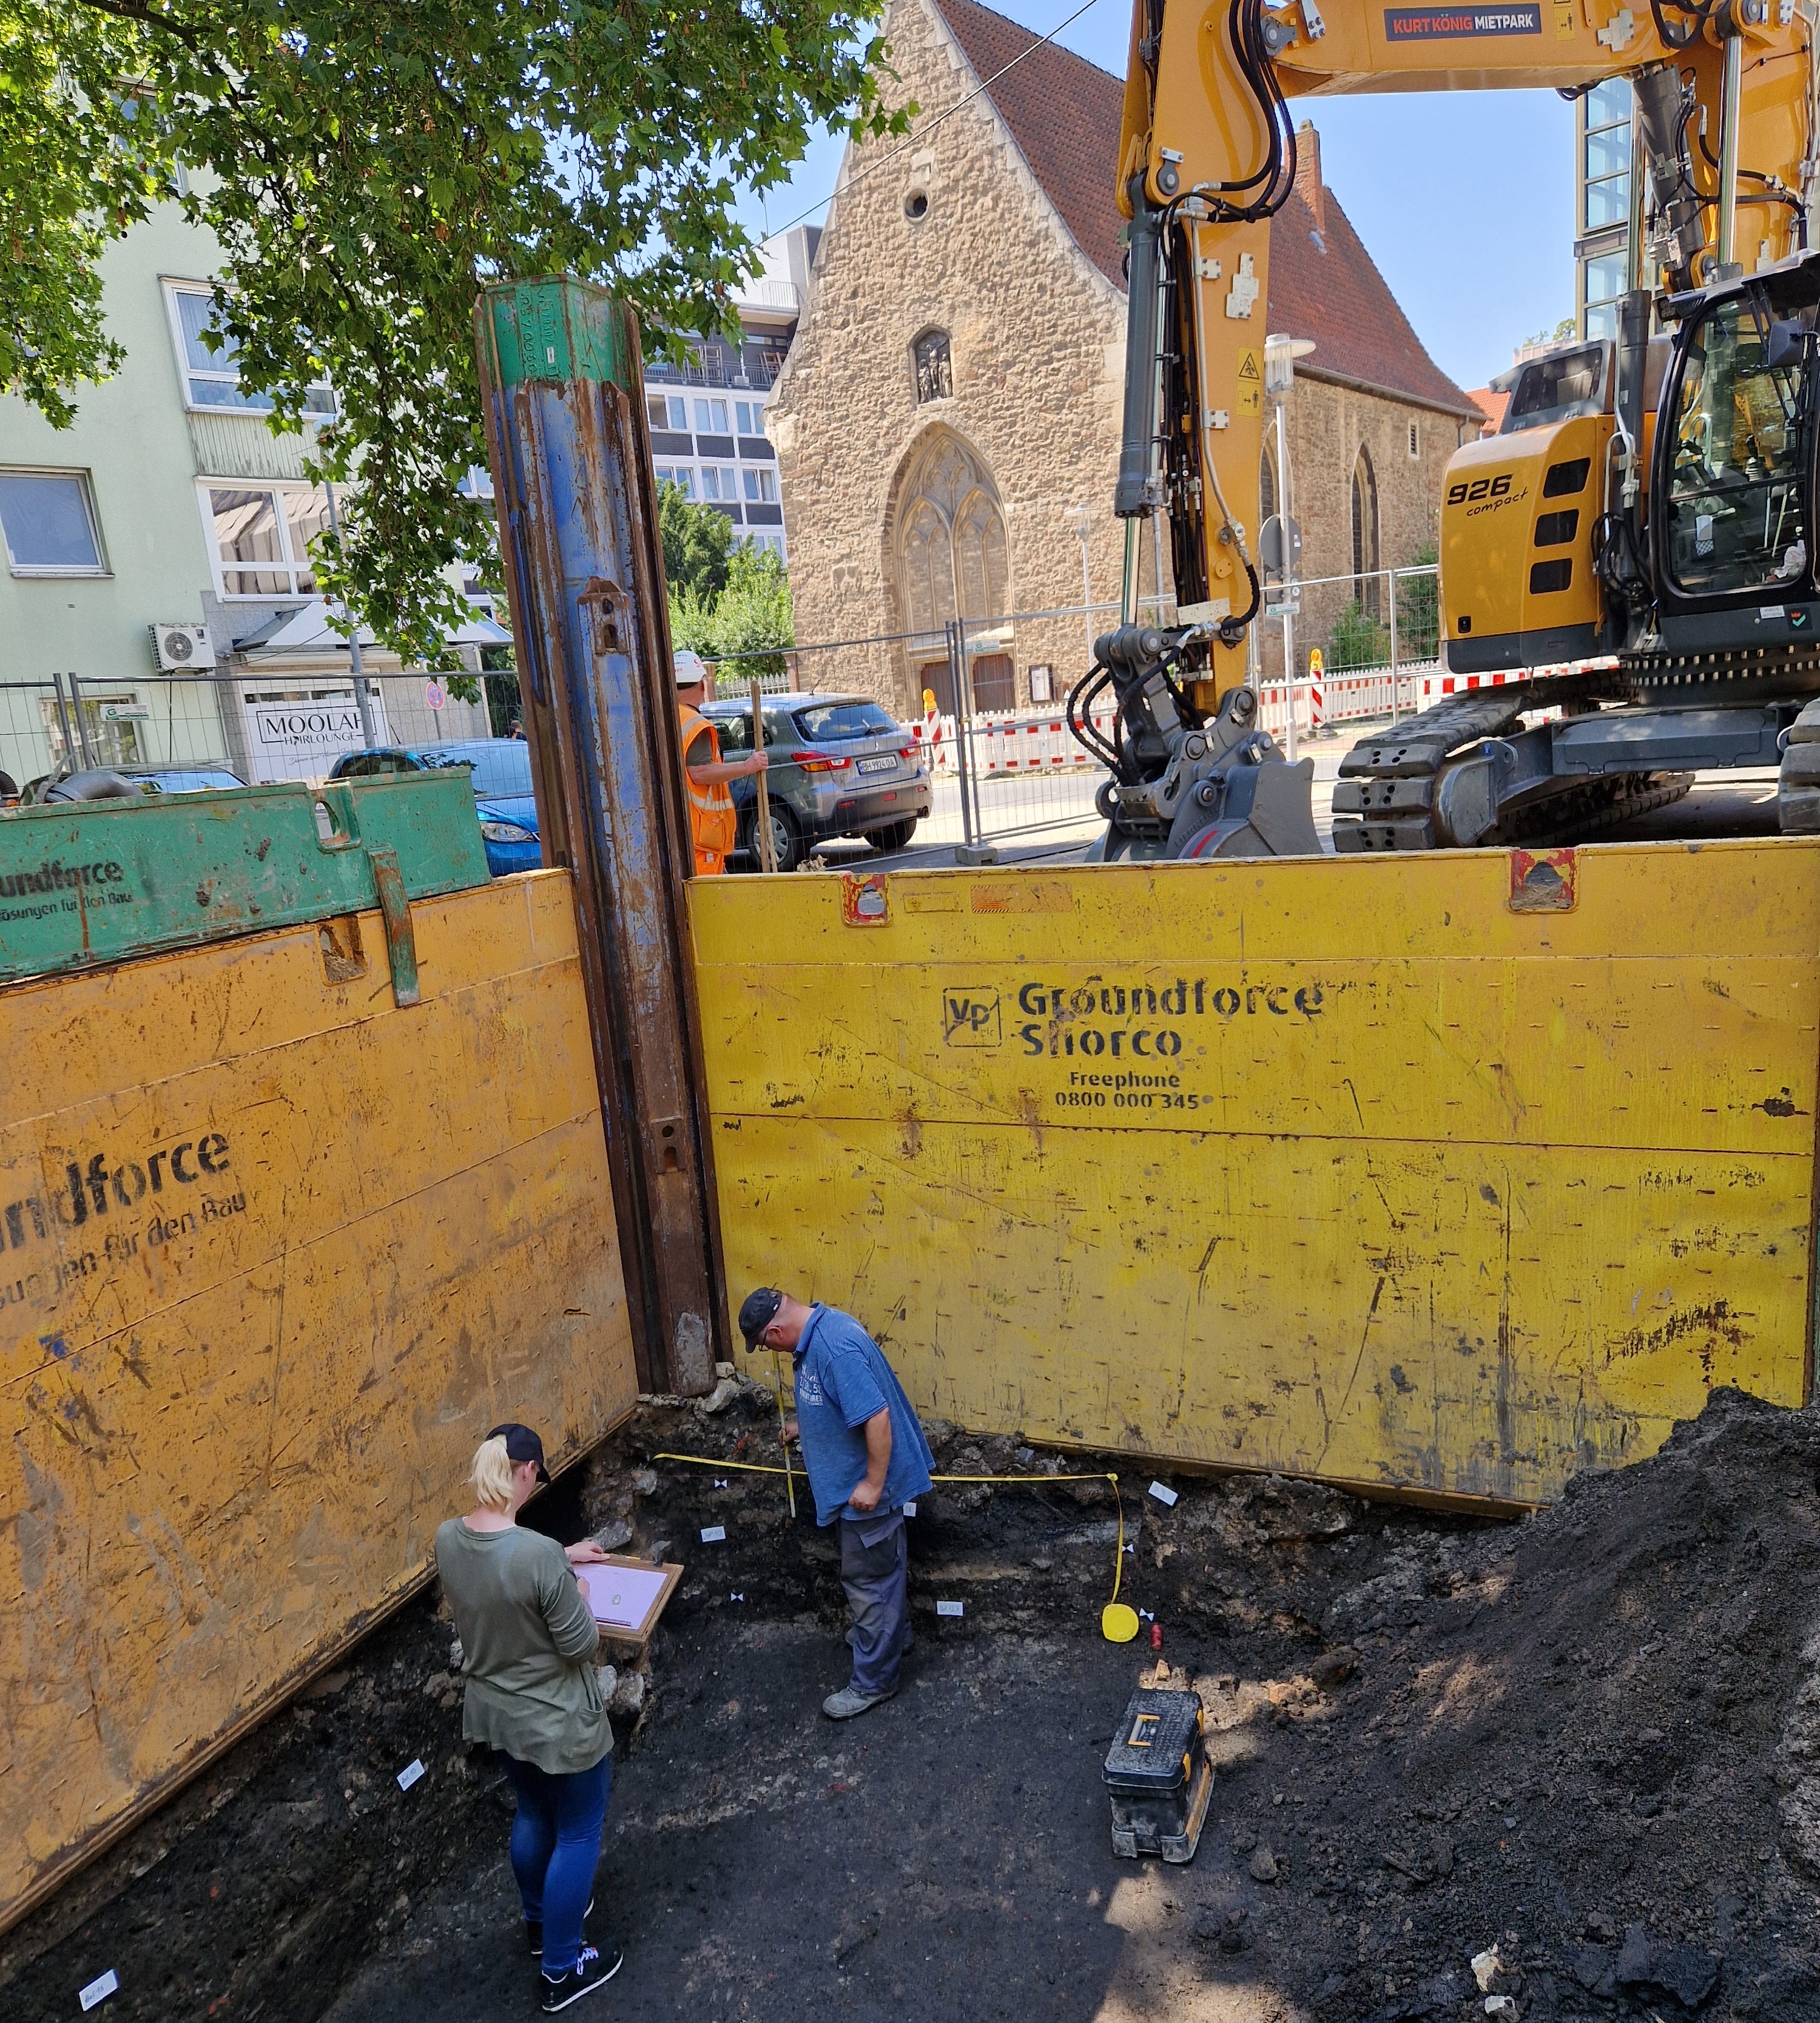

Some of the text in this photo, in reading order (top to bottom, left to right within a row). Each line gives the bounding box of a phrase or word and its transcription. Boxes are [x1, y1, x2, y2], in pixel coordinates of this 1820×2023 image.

[1393, 13, 1534, 34] KURT KÖNIG MIETPARK
[1447, 473, 1514, 505] 926
[1466, 486, 1529, 517] compact
[1018, 978, 1323, 1016] Groundforce
[949, 999, 990, 1032] Vp
[1020, 1020, 1182, 1056] Shorco
[1070, 1071, 1181, 1089] Freephone
[1055, 1092, 1199, 1110] 0800 000 345
